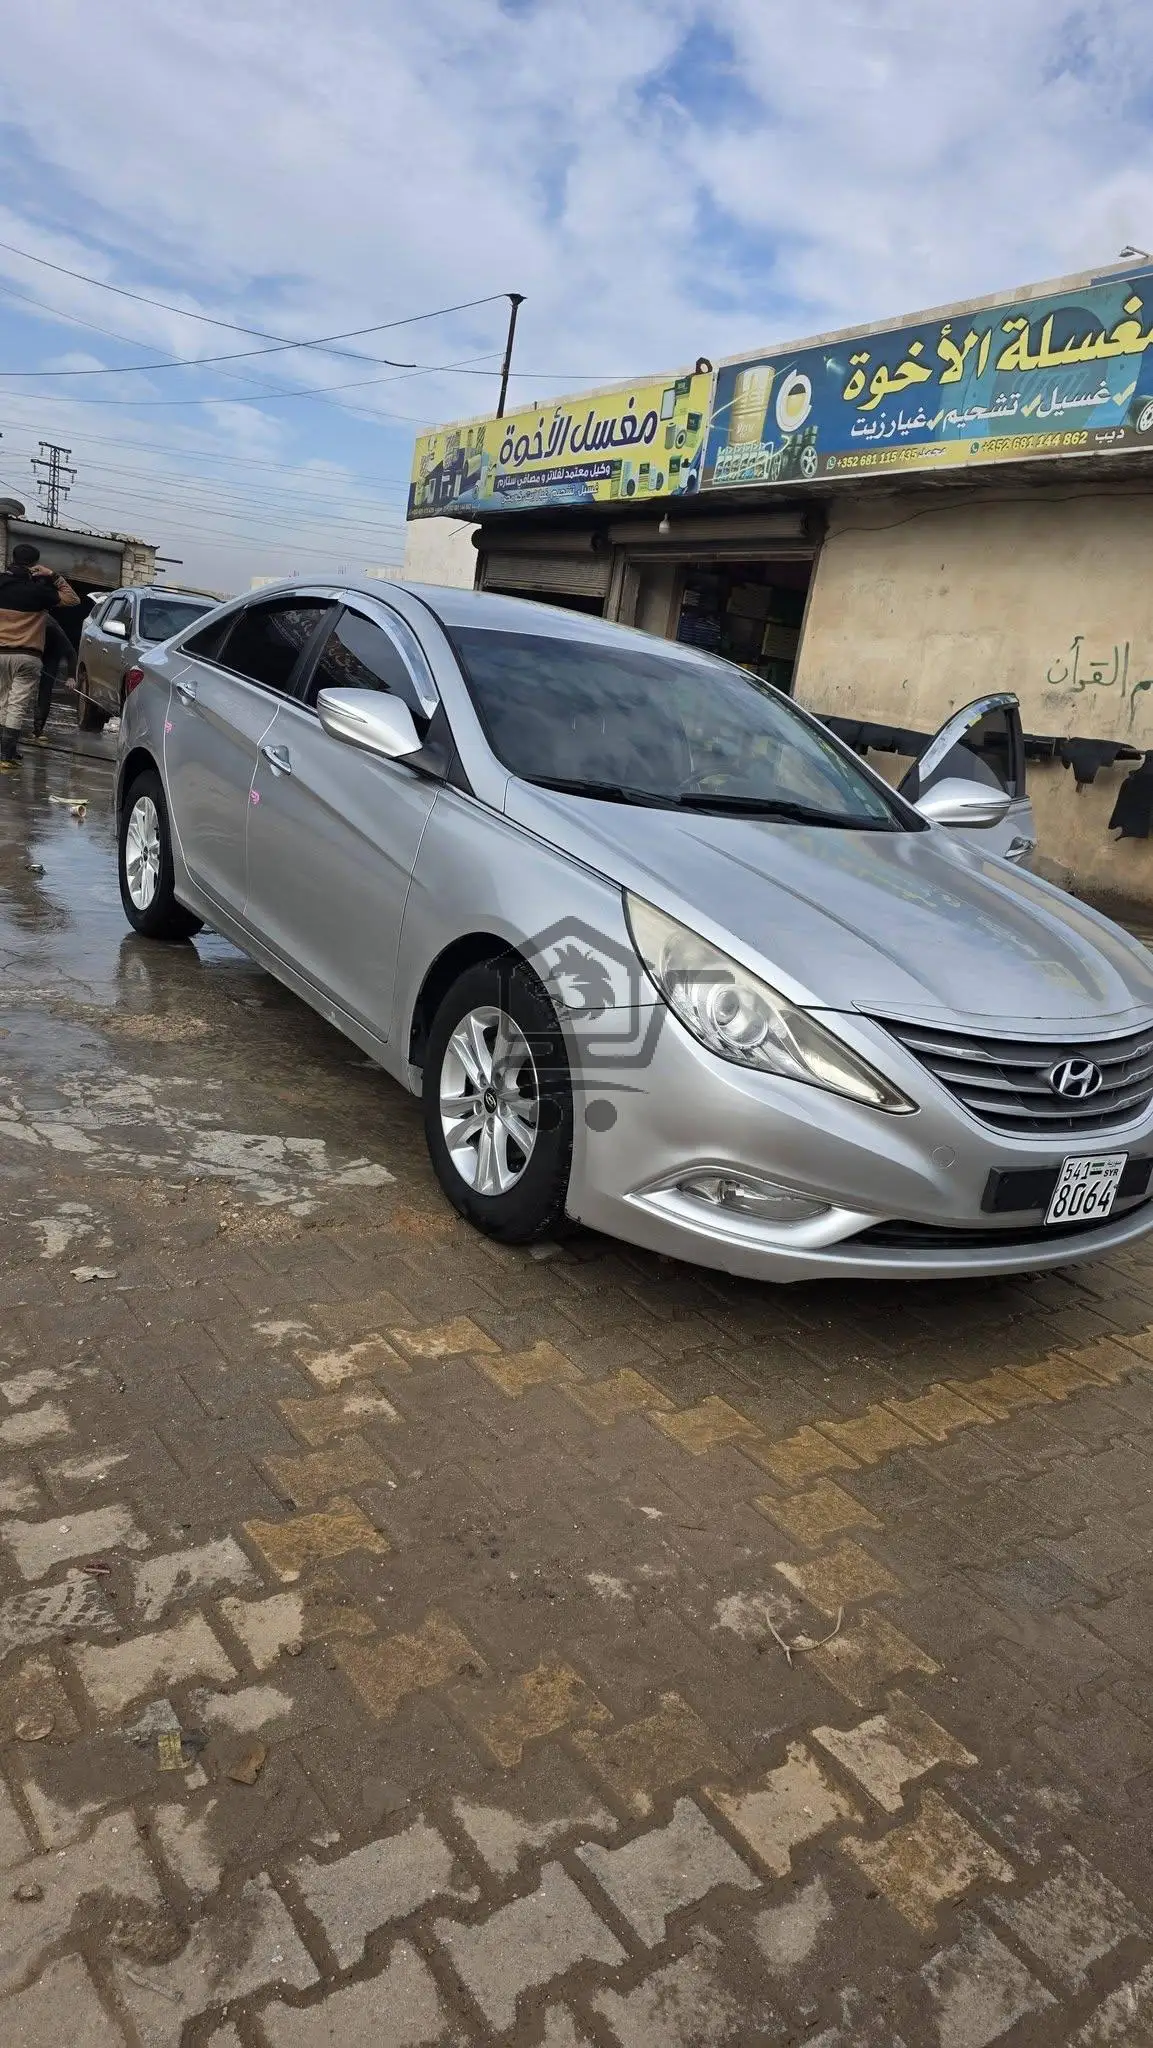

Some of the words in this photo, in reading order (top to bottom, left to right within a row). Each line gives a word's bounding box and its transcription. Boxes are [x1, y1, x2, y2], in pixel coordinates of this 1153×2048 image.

[842, 325, 992, 411] الأخوة
[1035, 380, 1112, 418] غسيل
[942, 391, 1021, 432] تشحيم
[570, 396, 658, 453] مغسل
[499, 405, 572, 467] الأخوة
[1013, 435, 1035, 450] 681
[1036, 433, 1061, 448] 144
[1063, 431, 1089, 446] 862
[1094, 428, 1125, 444] ديب
[837, 455, 859, 469] +352
[860, 452, 878, 466] 681
[879, 450, 898, 464] 115
[899, 447, 918, 461] 435
[565, 467, 589, 480] معتمد
[590, 463, 611, 478] وكيل
[1063, 1161, 1091, 1181] 541
[1103, 1168, 1119, 1177] SYR
[1053, 1180, 1113, 1218] 8064
